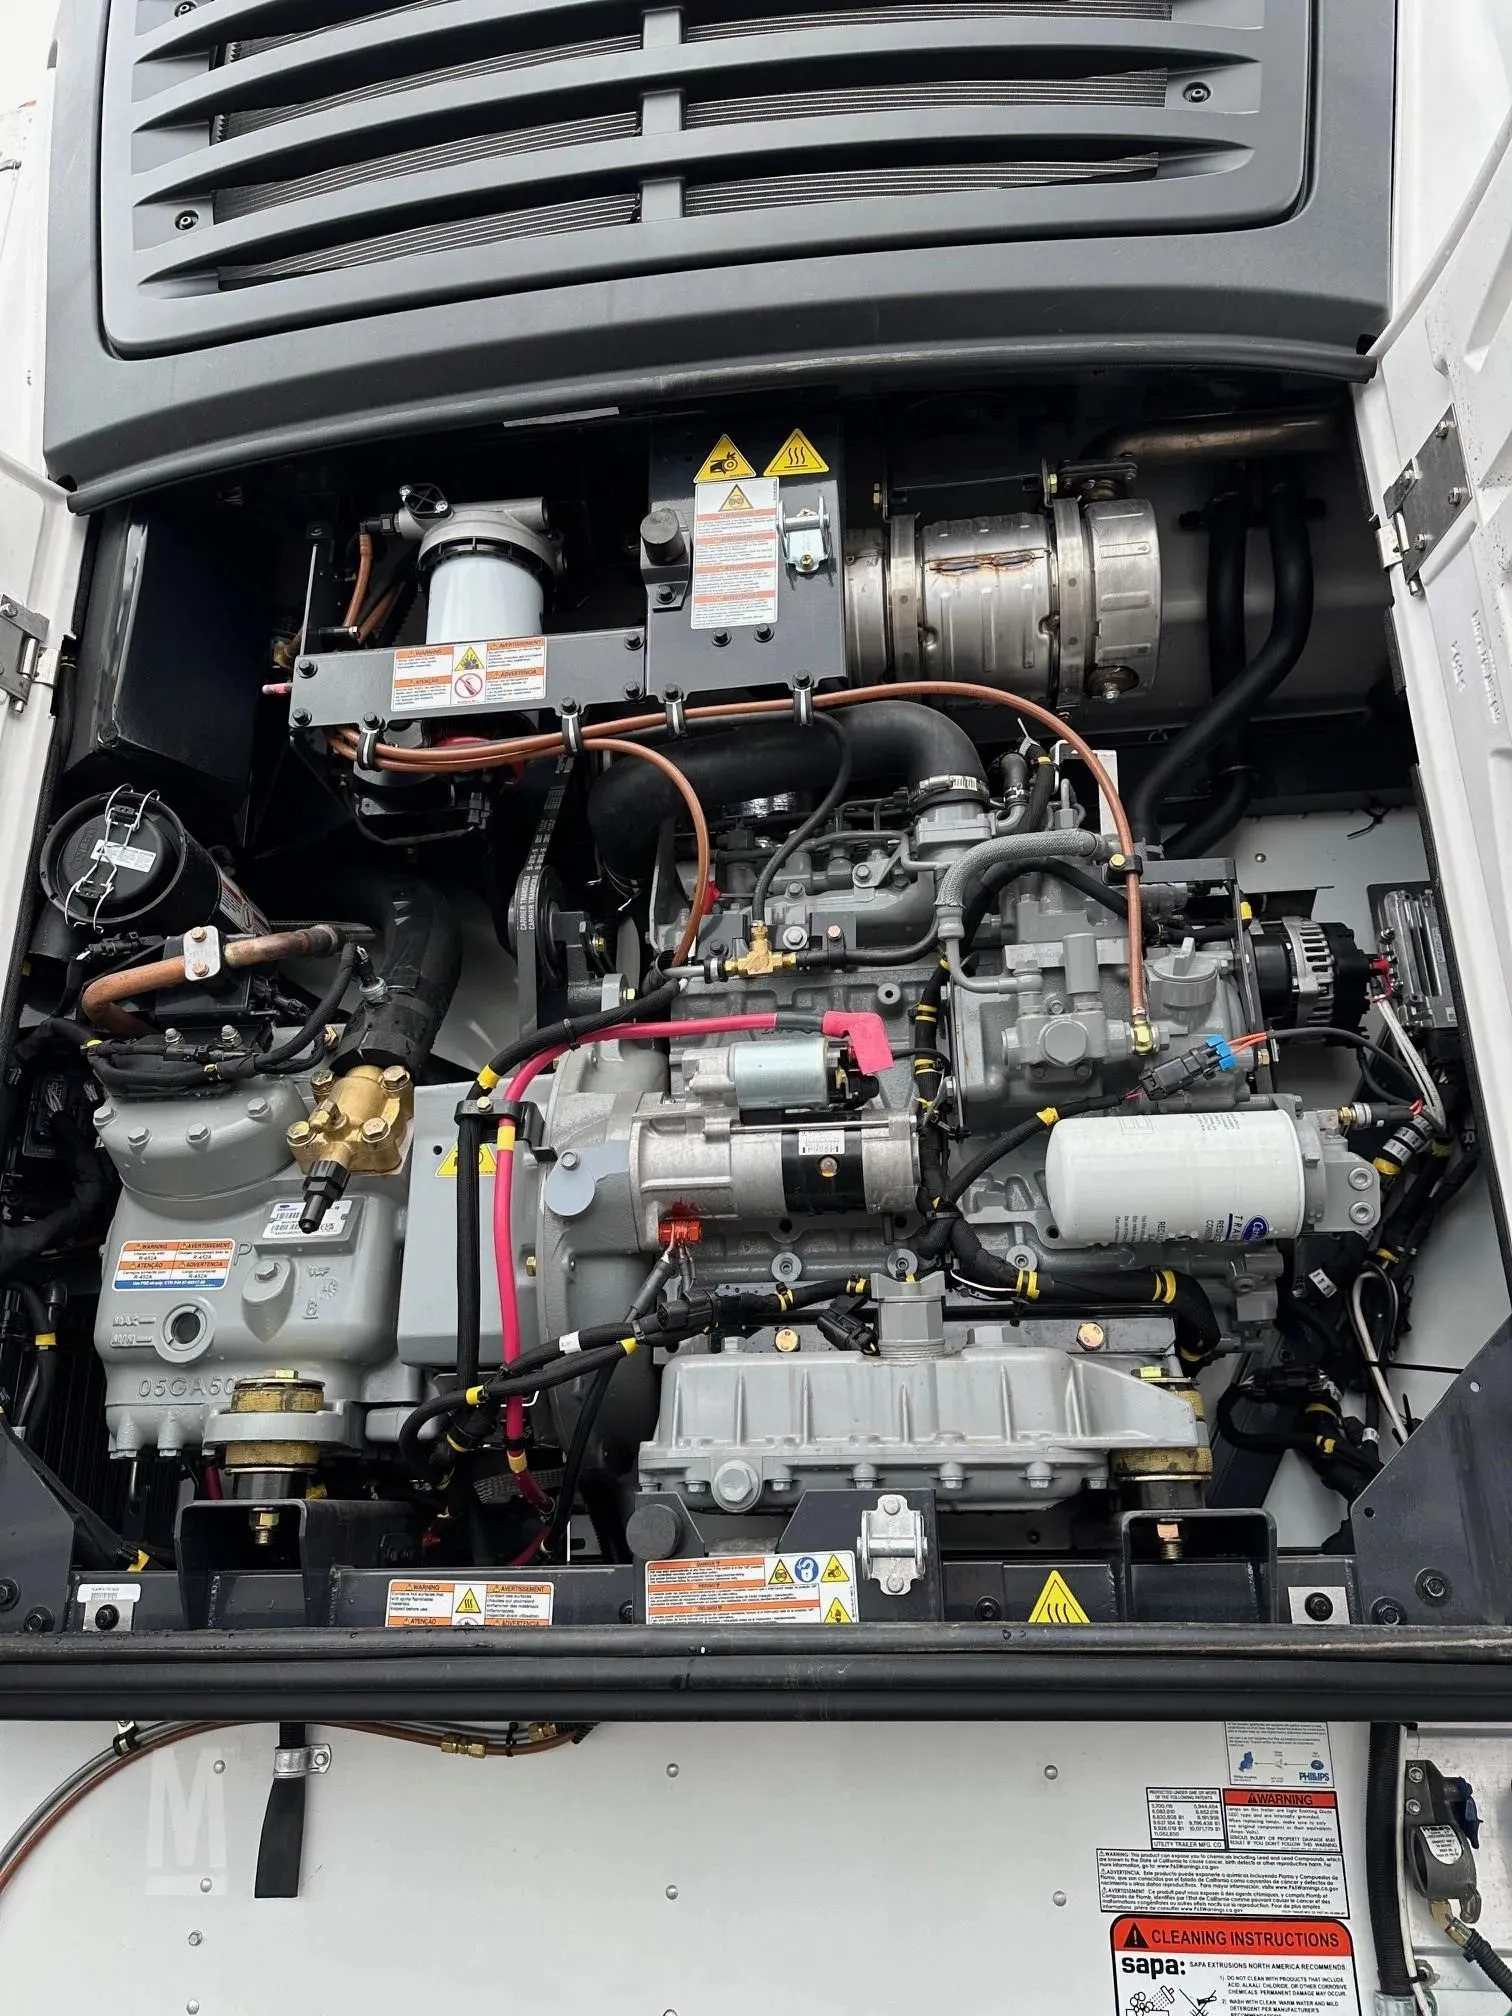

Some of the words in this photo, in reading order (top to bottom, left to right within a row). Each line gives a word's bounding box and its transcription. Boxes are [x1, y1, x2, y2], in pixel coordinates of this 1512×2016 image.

[1257, 1794, 1312, 1805] WARNING
[1152, 1929, 1227, 1945] CLEANING
[1230, 1931, 1339, 1947] INSTRUCTIONS
[1122, 1957, 1186, 1979] sapa:
